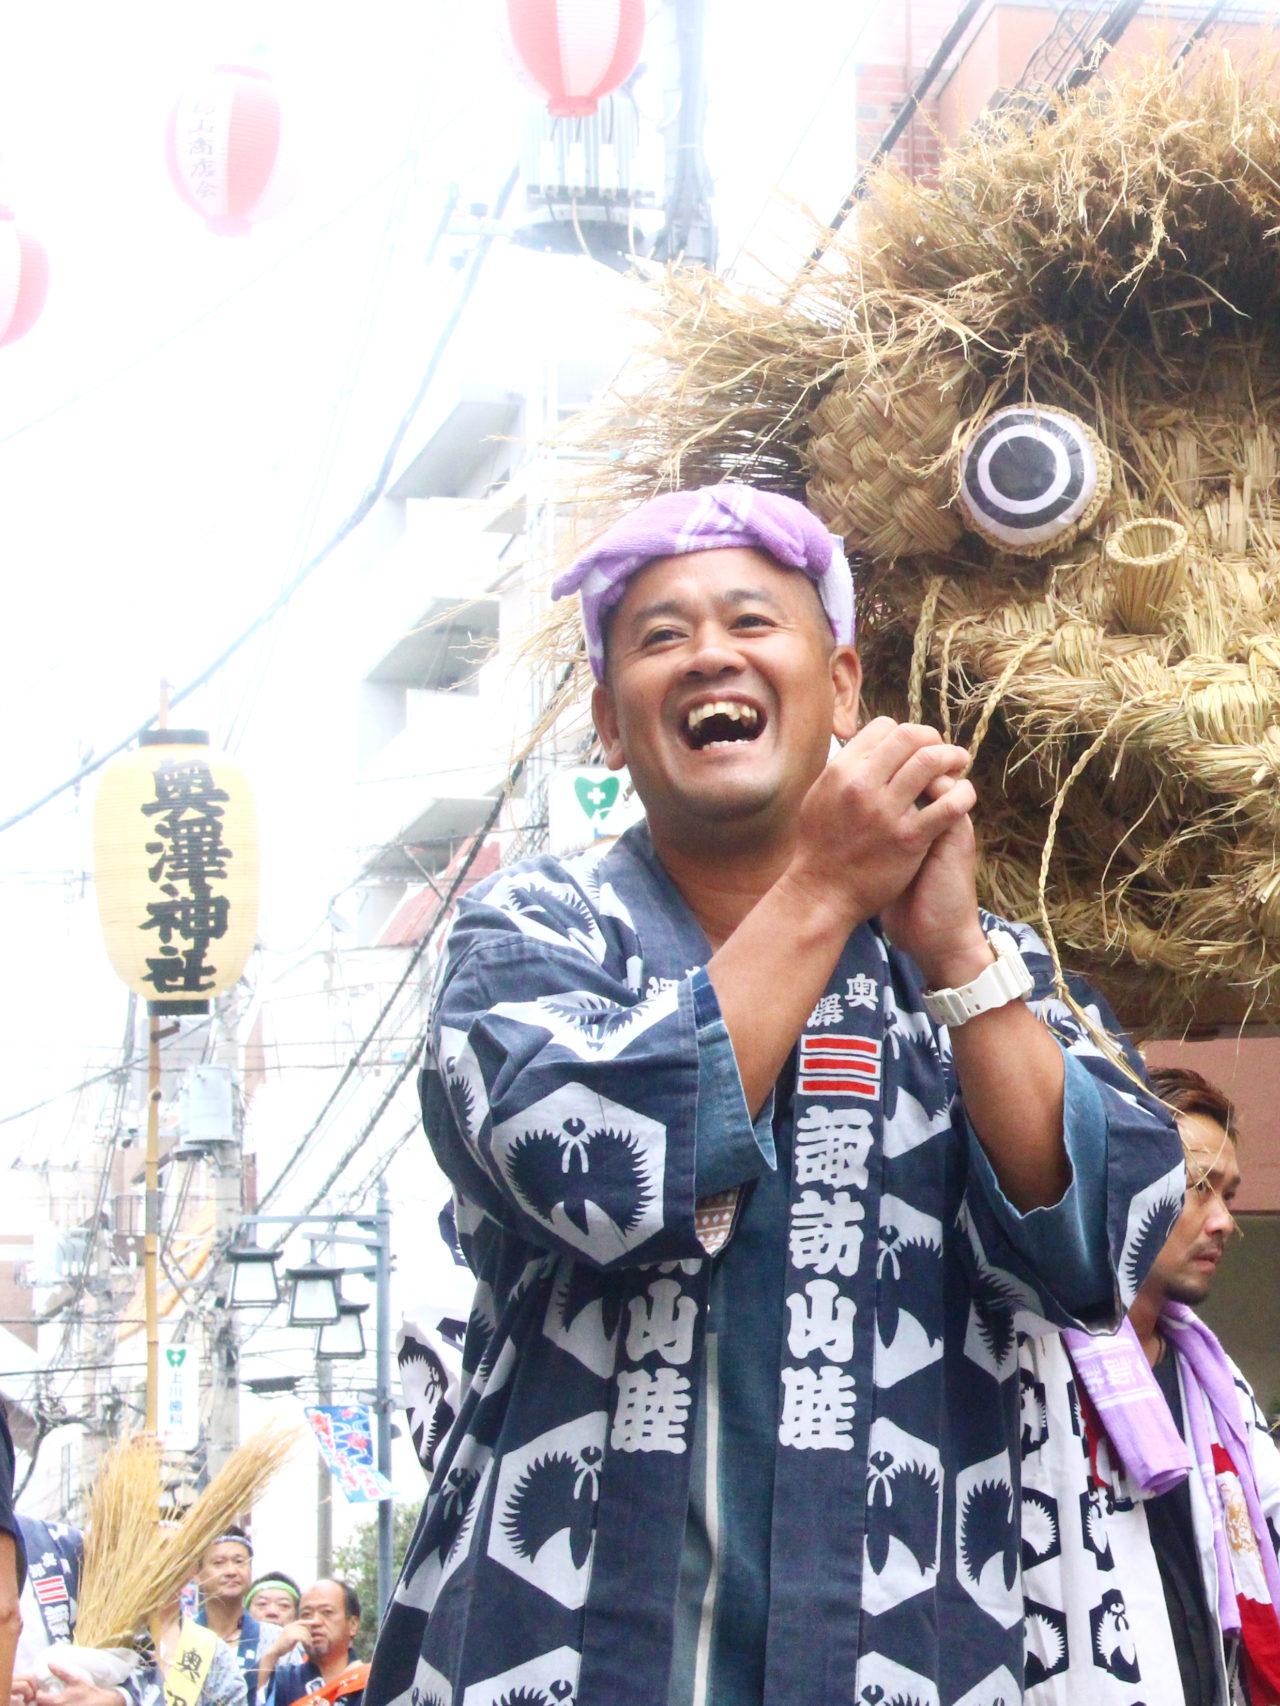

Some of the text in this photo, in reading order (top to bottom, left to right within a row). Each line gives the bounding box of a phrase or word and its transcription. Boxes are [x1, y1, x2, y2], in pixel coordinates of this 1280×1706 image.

[611, 1258, 702, 1456] 山睦
[777, 1105, 874, 1451] 諏訪山睦
